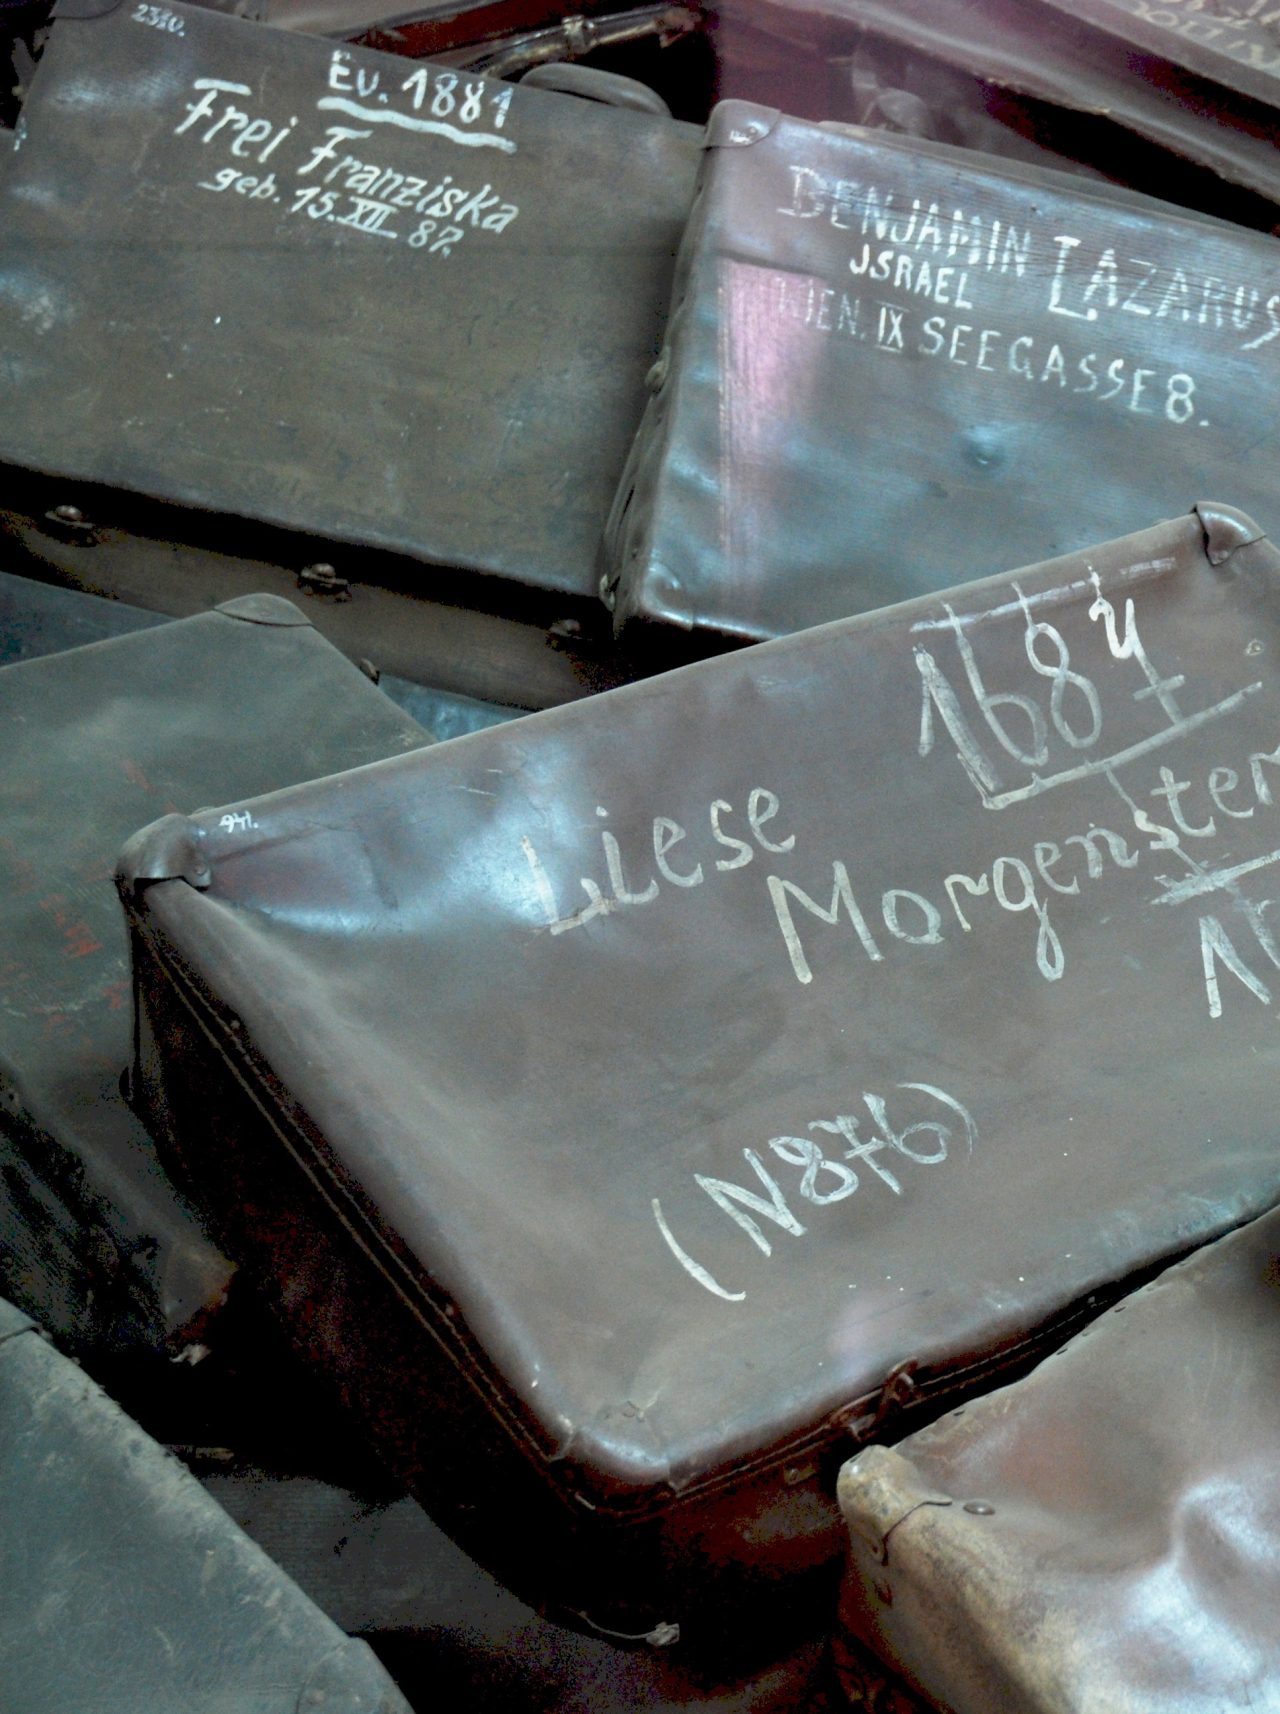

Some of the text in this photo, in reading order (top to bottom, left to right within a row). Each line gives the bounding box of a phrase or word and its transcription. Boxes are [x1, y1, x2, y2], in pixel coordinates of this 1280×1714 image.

[175, 79, 519, 234] Frei Franziska
[198, 167, 280, 204] geb.
[777, 165, 1032, 277] BENJAMIN
